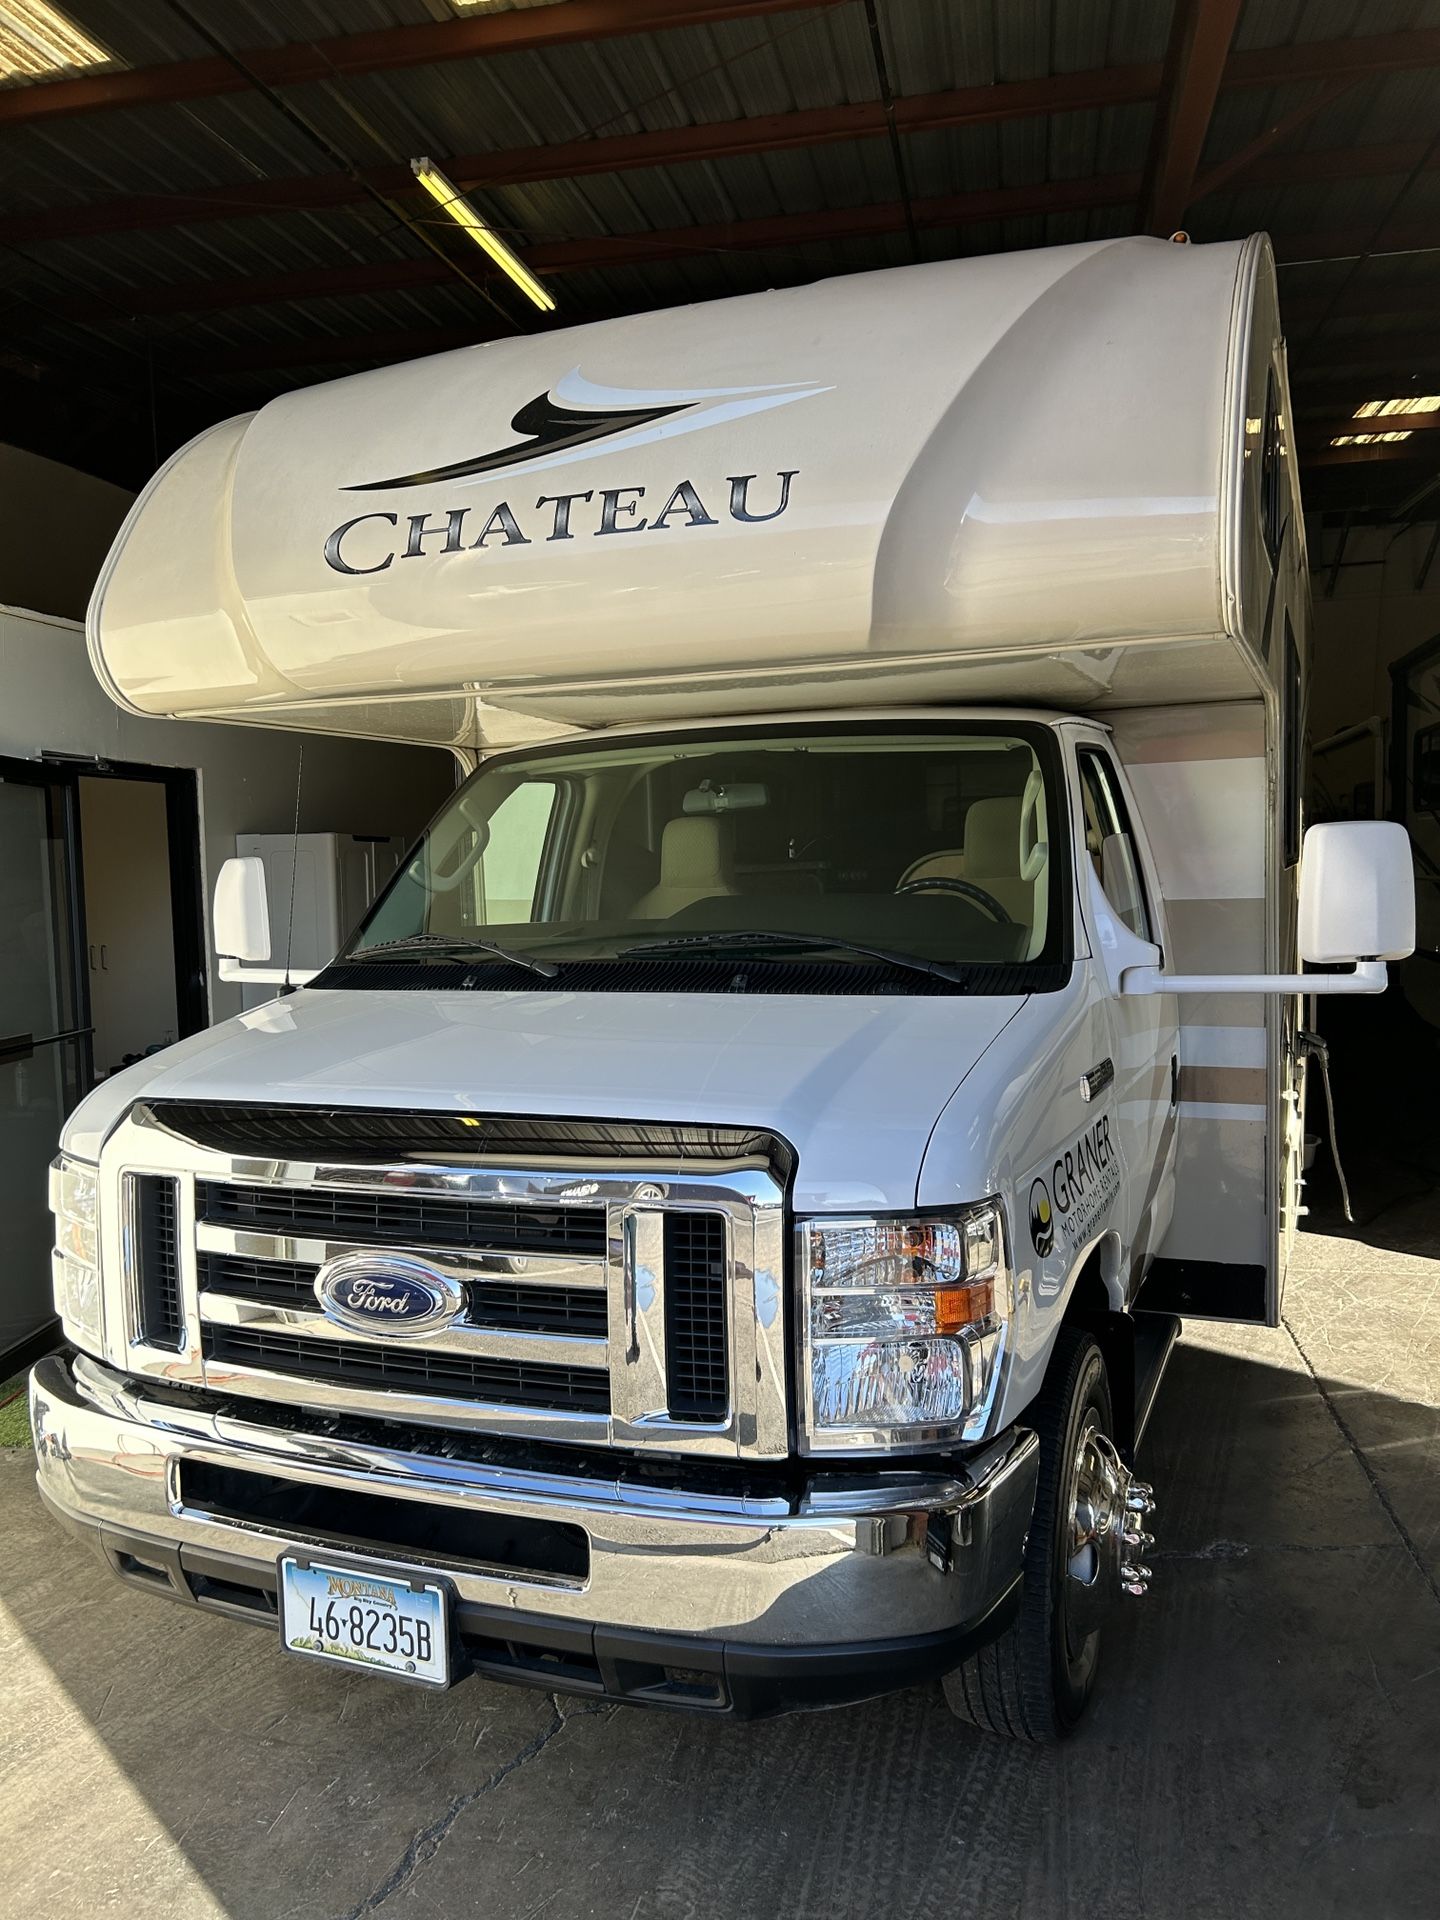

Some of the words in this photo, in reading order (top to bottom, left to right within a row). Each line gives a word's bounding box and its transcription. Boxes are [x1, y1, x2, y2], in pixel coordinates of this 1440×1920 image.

[324, 470, 800, 575] CHATEAU
[1053, 1114, 1115, 1214] GRANER
[1061, 1184, 1102, 1240] MOTORHOME
[347, 1278, 410, 1315] Ford
[327, 1575, 397, 1606] MONTANA
